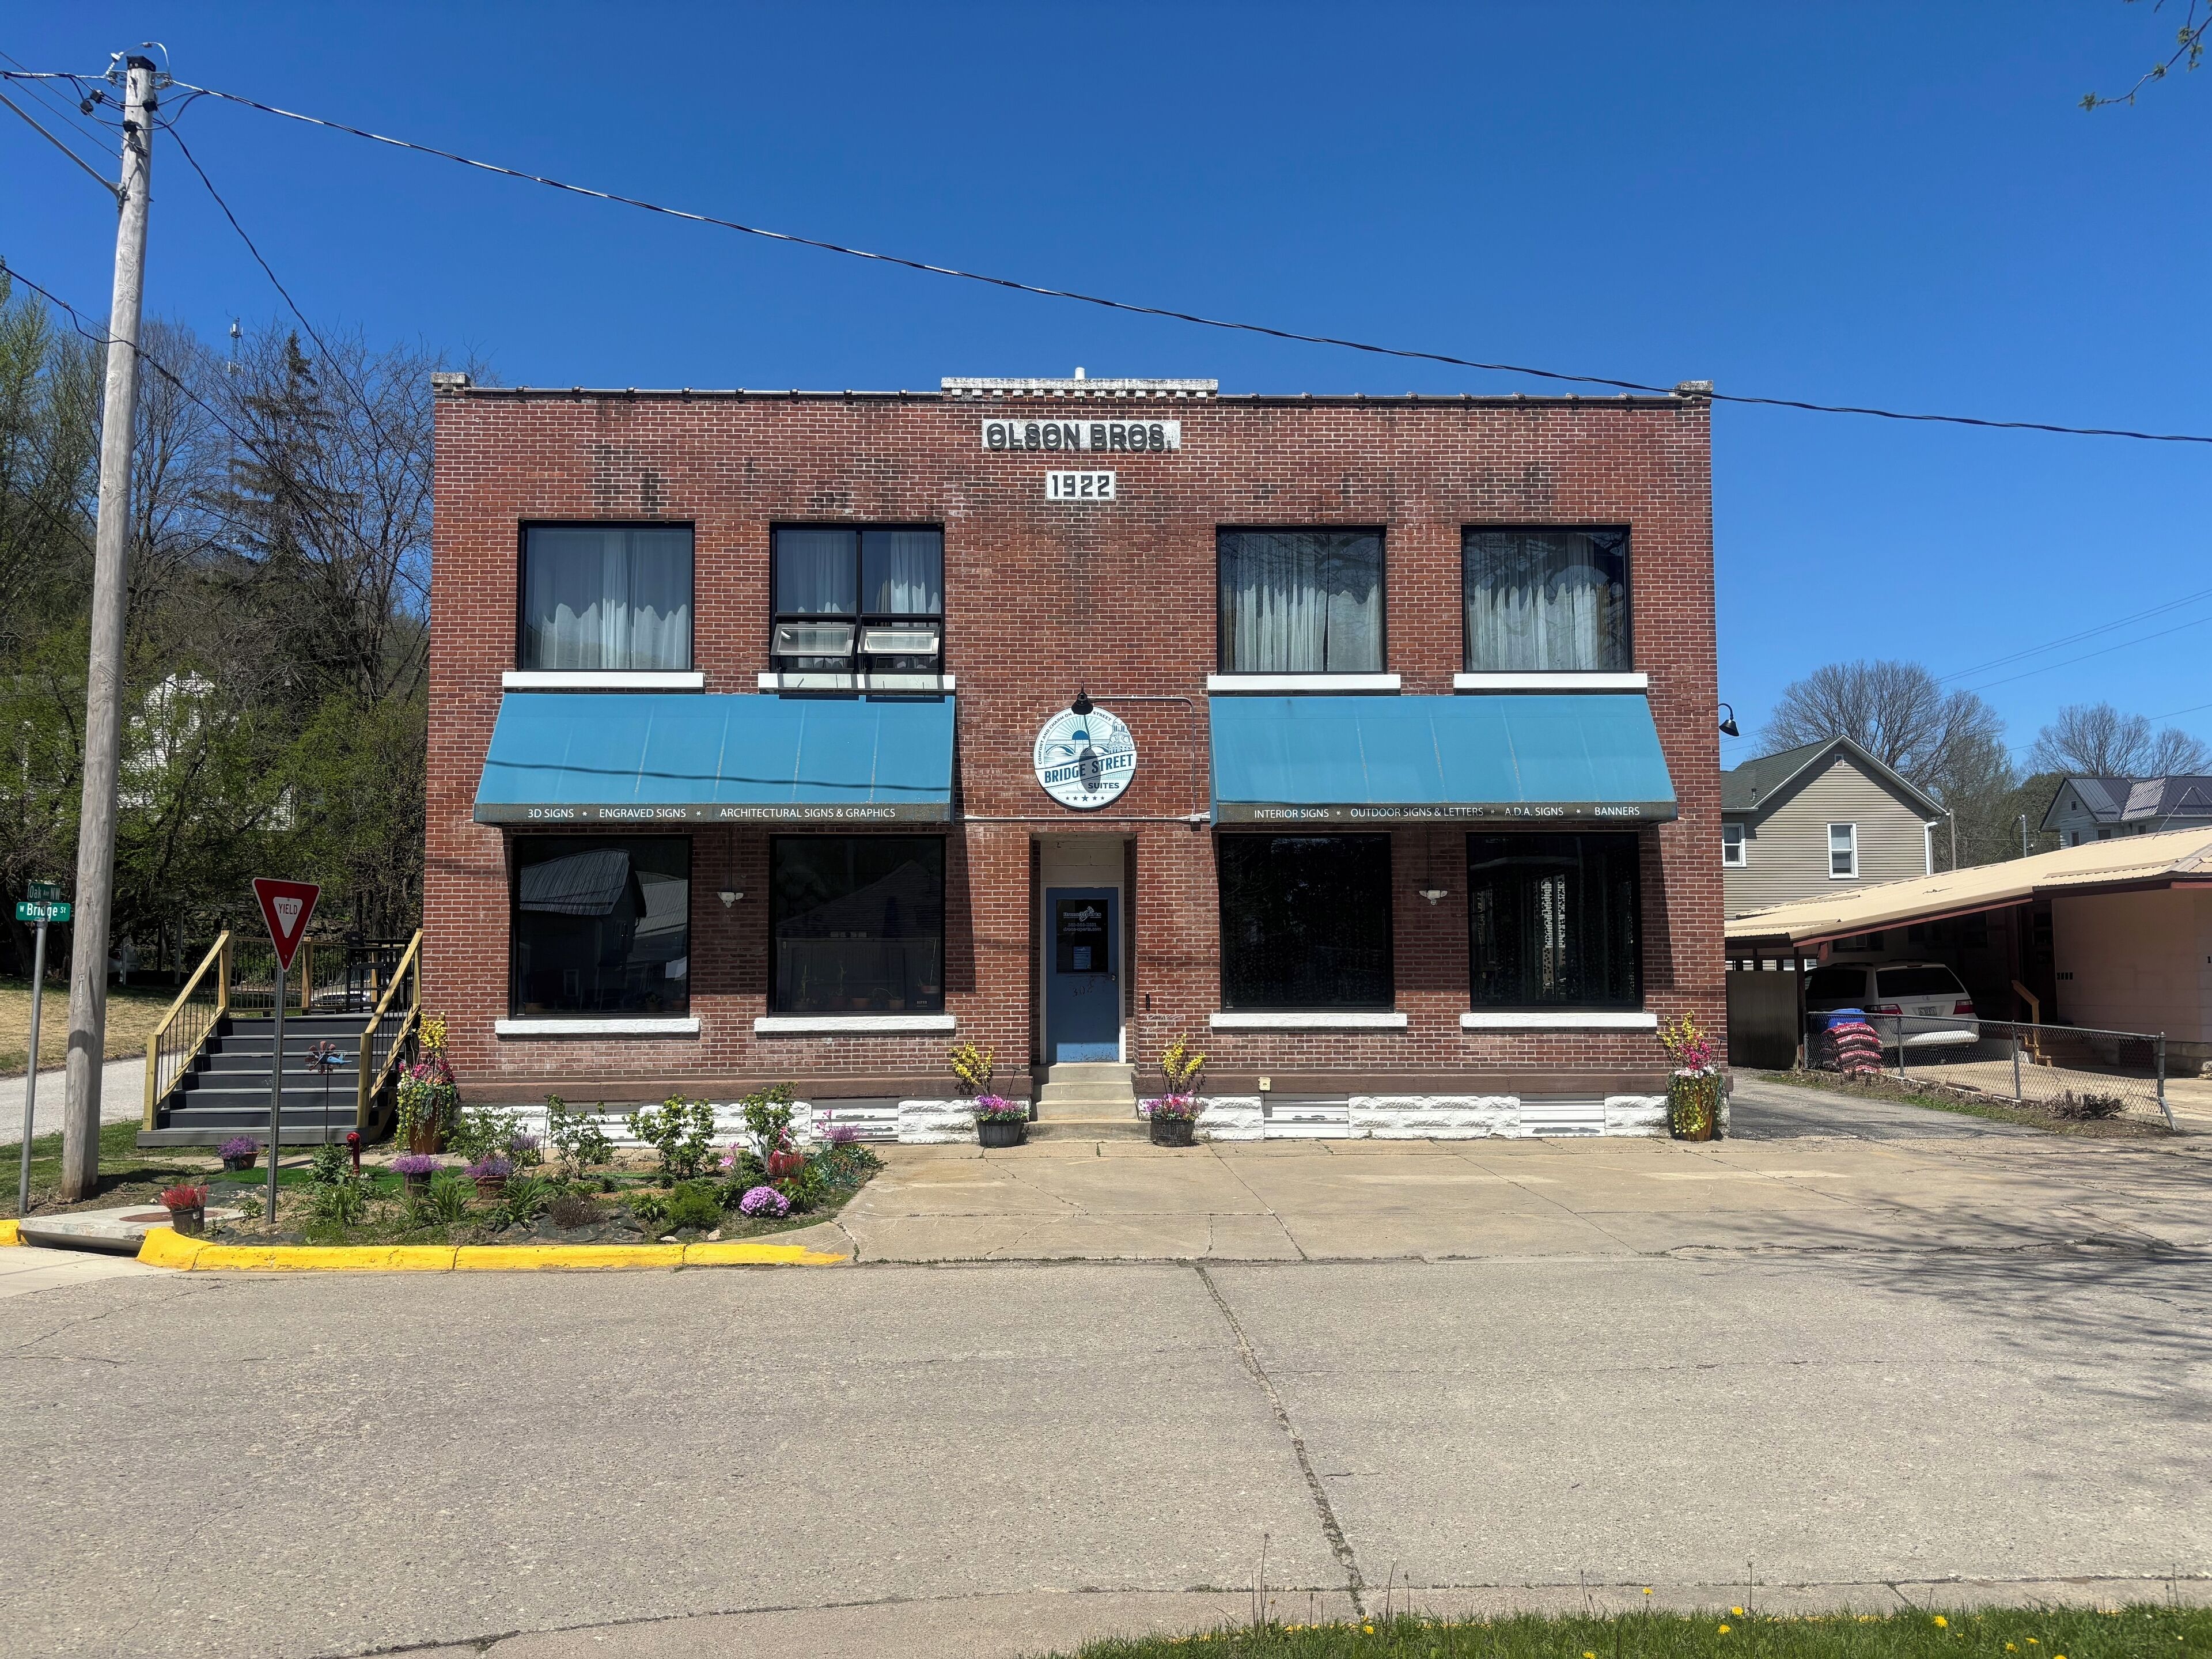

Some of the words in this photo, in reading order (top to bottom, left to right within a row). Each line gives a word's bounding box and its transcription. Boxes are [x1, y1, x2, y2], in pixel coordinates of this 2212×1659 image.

[987, 423, 1080, 450] OLSON
[1090, 423, 1172, 452] BROS.
[1052, 474, 1111, 497] 1922
[1049, 716, 1065, 729] CHARM
[1093, 711, 1112, 721] STREET
[1044, 763, 1086, 783] BRIDGE
[1092, 753, 1133, 774] STREET
[528, 809, 541, 818] 3D
[544, 809, 574, 818] SIGNS
[599, 808, 654, 818] ENGRAVED
[656, 808, 686, 818] SIGNS
[720, 808, 802, 817] ARCHITECTURAL
[804, 808, 834, 817] SIGNS
[836, 808, 844, 817] &
[846, 808, 896, 817] GRAPHICS
[1254, 809, 1298, 819] INTERIOR
[1301, 809, 1329, 818] SIGNS
[1350, 808, 1400, 817] OUTDOOR
[1403, 808, 1432, 817] SIGNS
[1434, 808, 1441, 817] &
[1444, 808, 1484, 816] LETTERS
[1505, 808, 1533, 816] A.D.A.
[1535, 807, 1564, 816] SIGNS
[1594, 806, 1640, 816] BANNERS
[29, 885, 41, 899] Oak
[51, 888, 60, 900] NW
[26, 903, 58, 920] Bridge
[279, 903, 298, 915] YIELD
